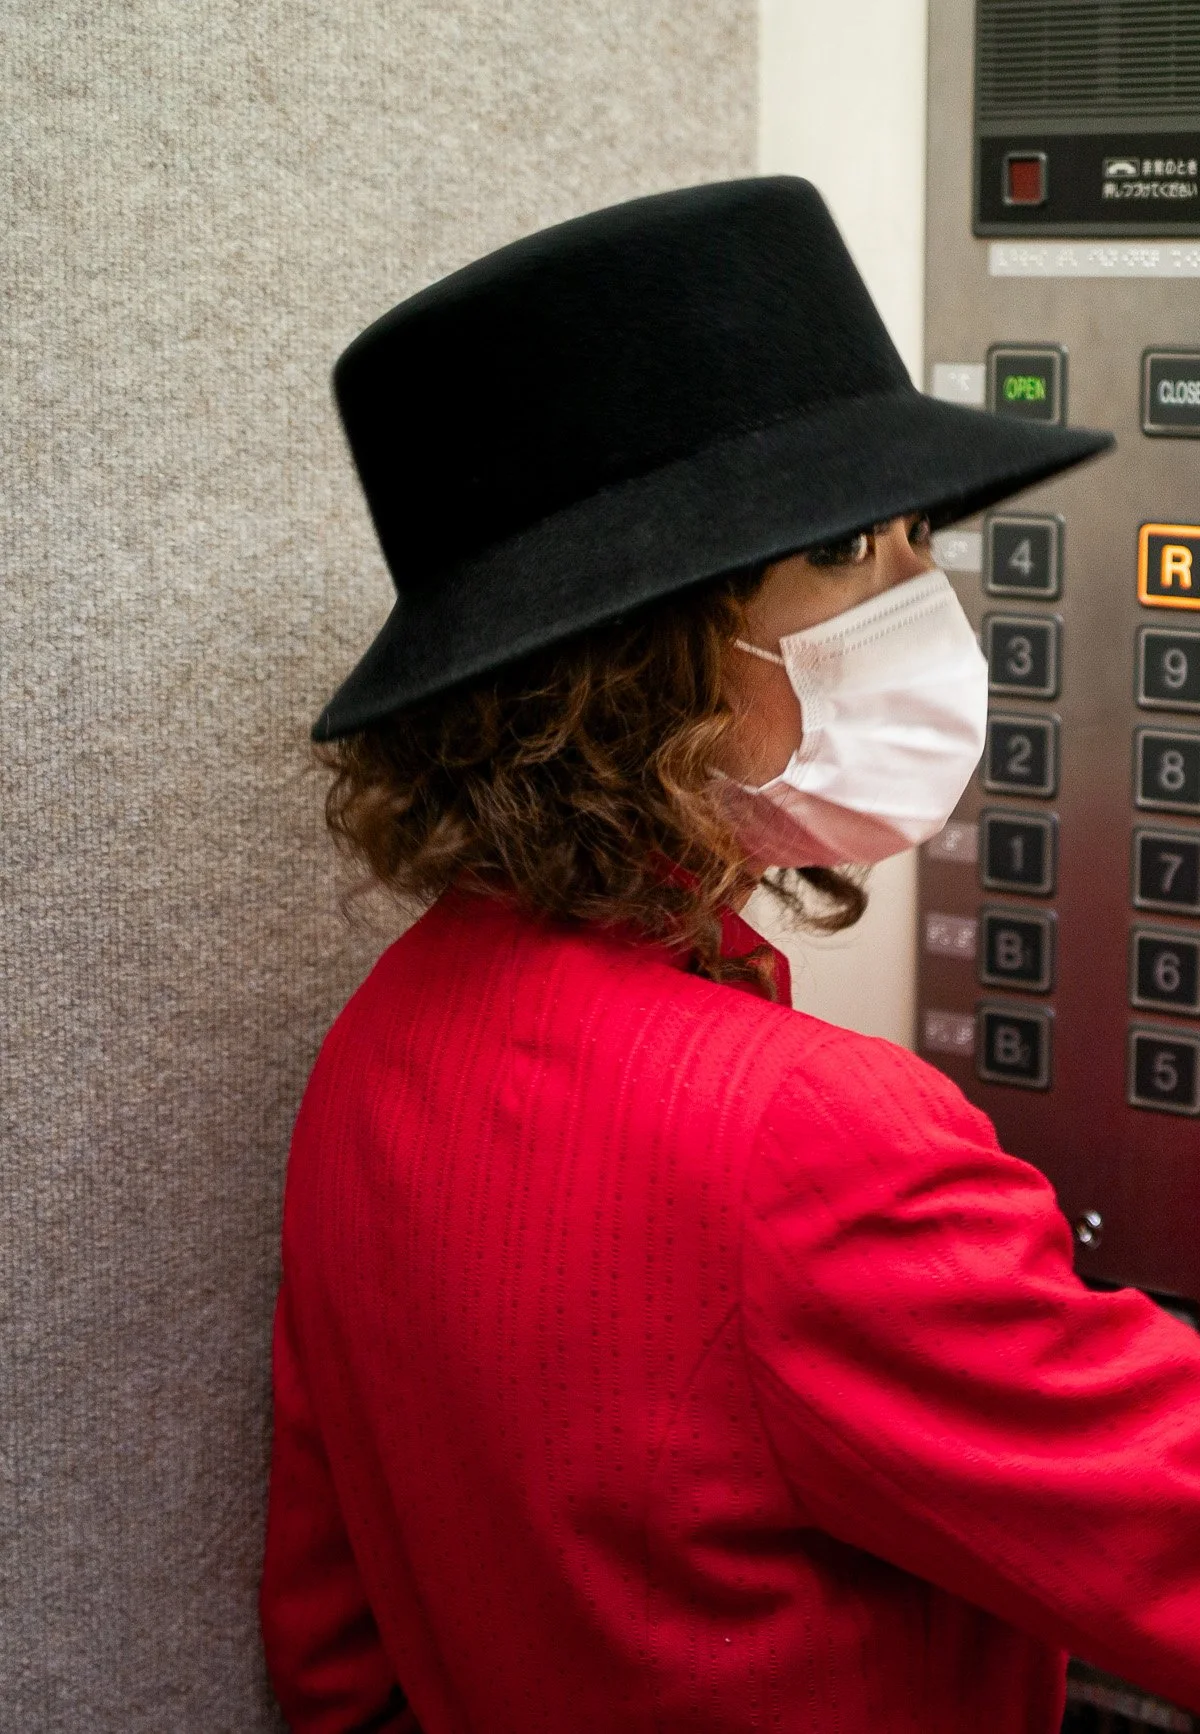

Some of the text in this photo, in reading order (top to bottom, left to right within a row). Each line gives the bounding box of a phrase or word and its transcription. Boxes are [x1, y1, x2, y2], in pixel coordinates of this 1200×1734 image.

[1004, 377, 1046, 400] OPEN
[1009, 541, 1033, 577] 4
[1160, 545, 1193, 589] R
[1008, 637, 1032, 676] 3
[1164, 650, 1187, 688] 9
[1007, 735, 1031, 774] 2
[1159, 750, 1184, 790] 8
[1010, 838, 1023, 872] 1
[1159, 854, 1183, 893] 7
[1156, 954, 1180, 992] 6
[1153, 1053, 1177, 1092] 5
